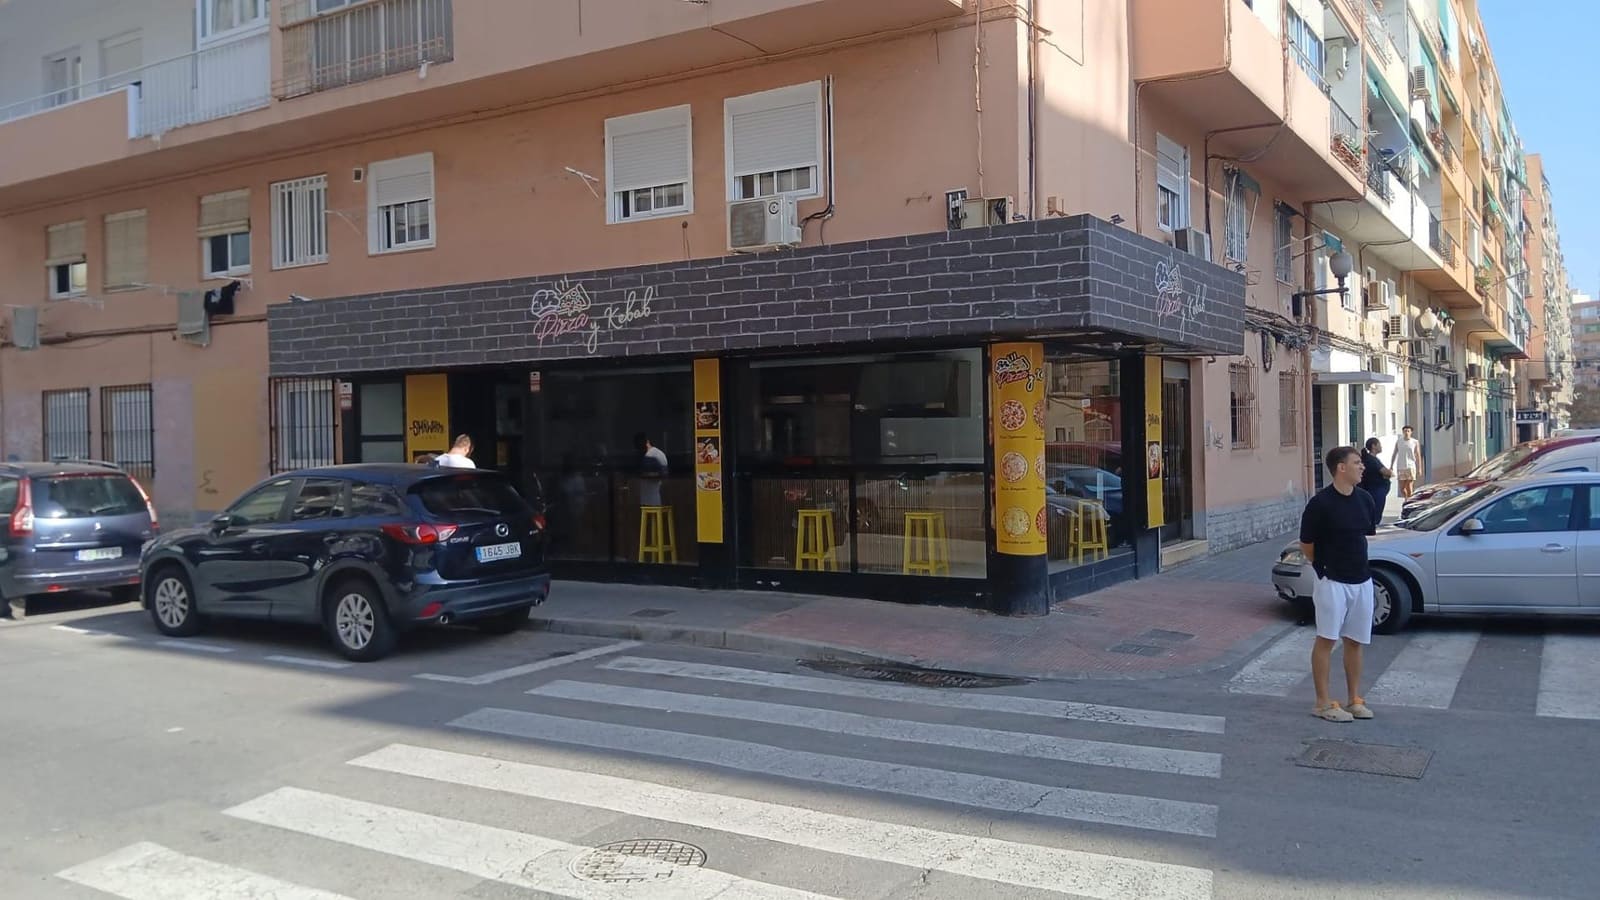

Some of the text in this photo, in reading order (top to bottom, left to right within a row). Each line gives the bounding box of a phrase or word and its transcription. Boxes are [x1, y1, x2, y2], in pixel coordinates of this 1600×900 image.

[533, 286, 654, 354] Pizza y Kebab
